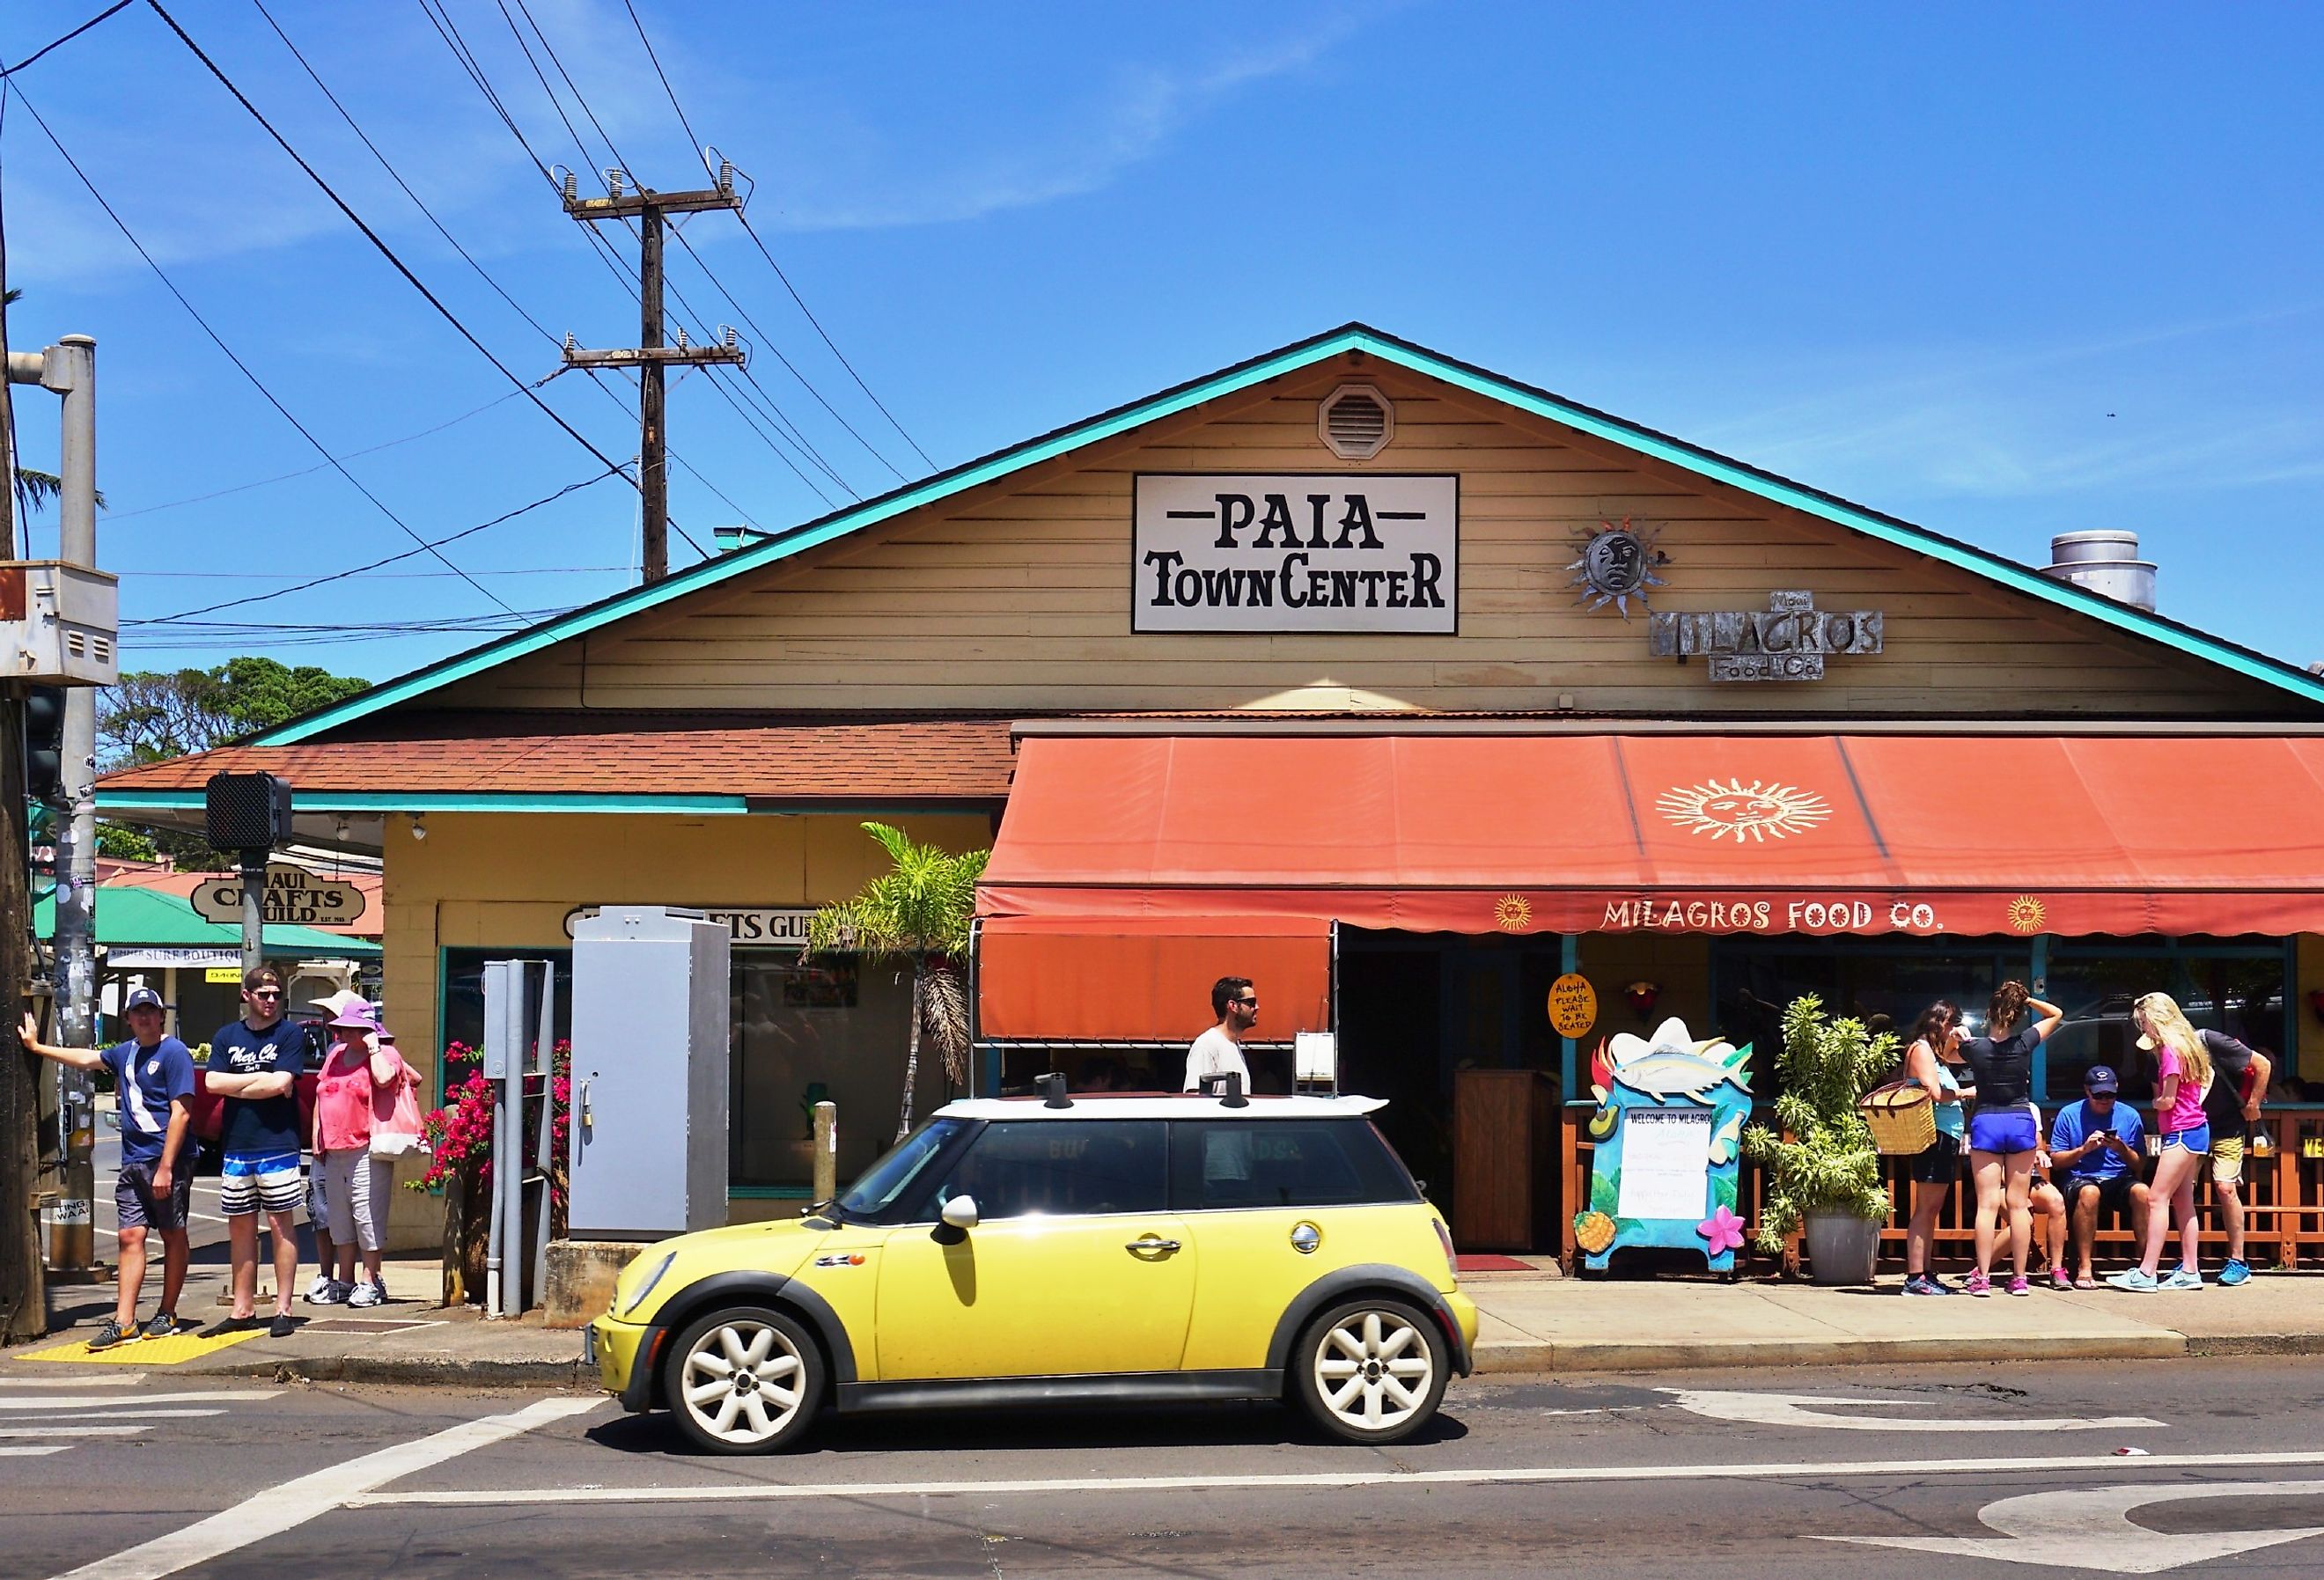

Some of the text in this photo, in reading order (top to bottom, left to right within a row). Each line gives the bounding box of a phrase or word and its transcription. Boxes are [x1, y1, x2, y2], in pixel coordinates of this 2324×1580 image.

[1215, 494, 1384, 549] PAIA
[1654, 613, 1879, 653] MILAGROS
[1714, 657, 1770, 677] Food
[213, 887, 344, 908] CAFTS
[263, 907, 317, 922] UILD
[1599, 899, 1944, 930] MILAGROS FOOD CO.
[146, 950, 180, 961] SURF
[183, 950, 243, 963] BOUTIQU
[1555, 981, 1586, 994] ALOHA
[1555, 995, 1590, 1005] PLEASE
[1558, 1021, 1592, 1032] SEATED
[1630, 1113, 1665, 1125] WELCOME
[1667, 1113, 1677, 1124] TO
[2304, 1137, 2324, 1157] VE
